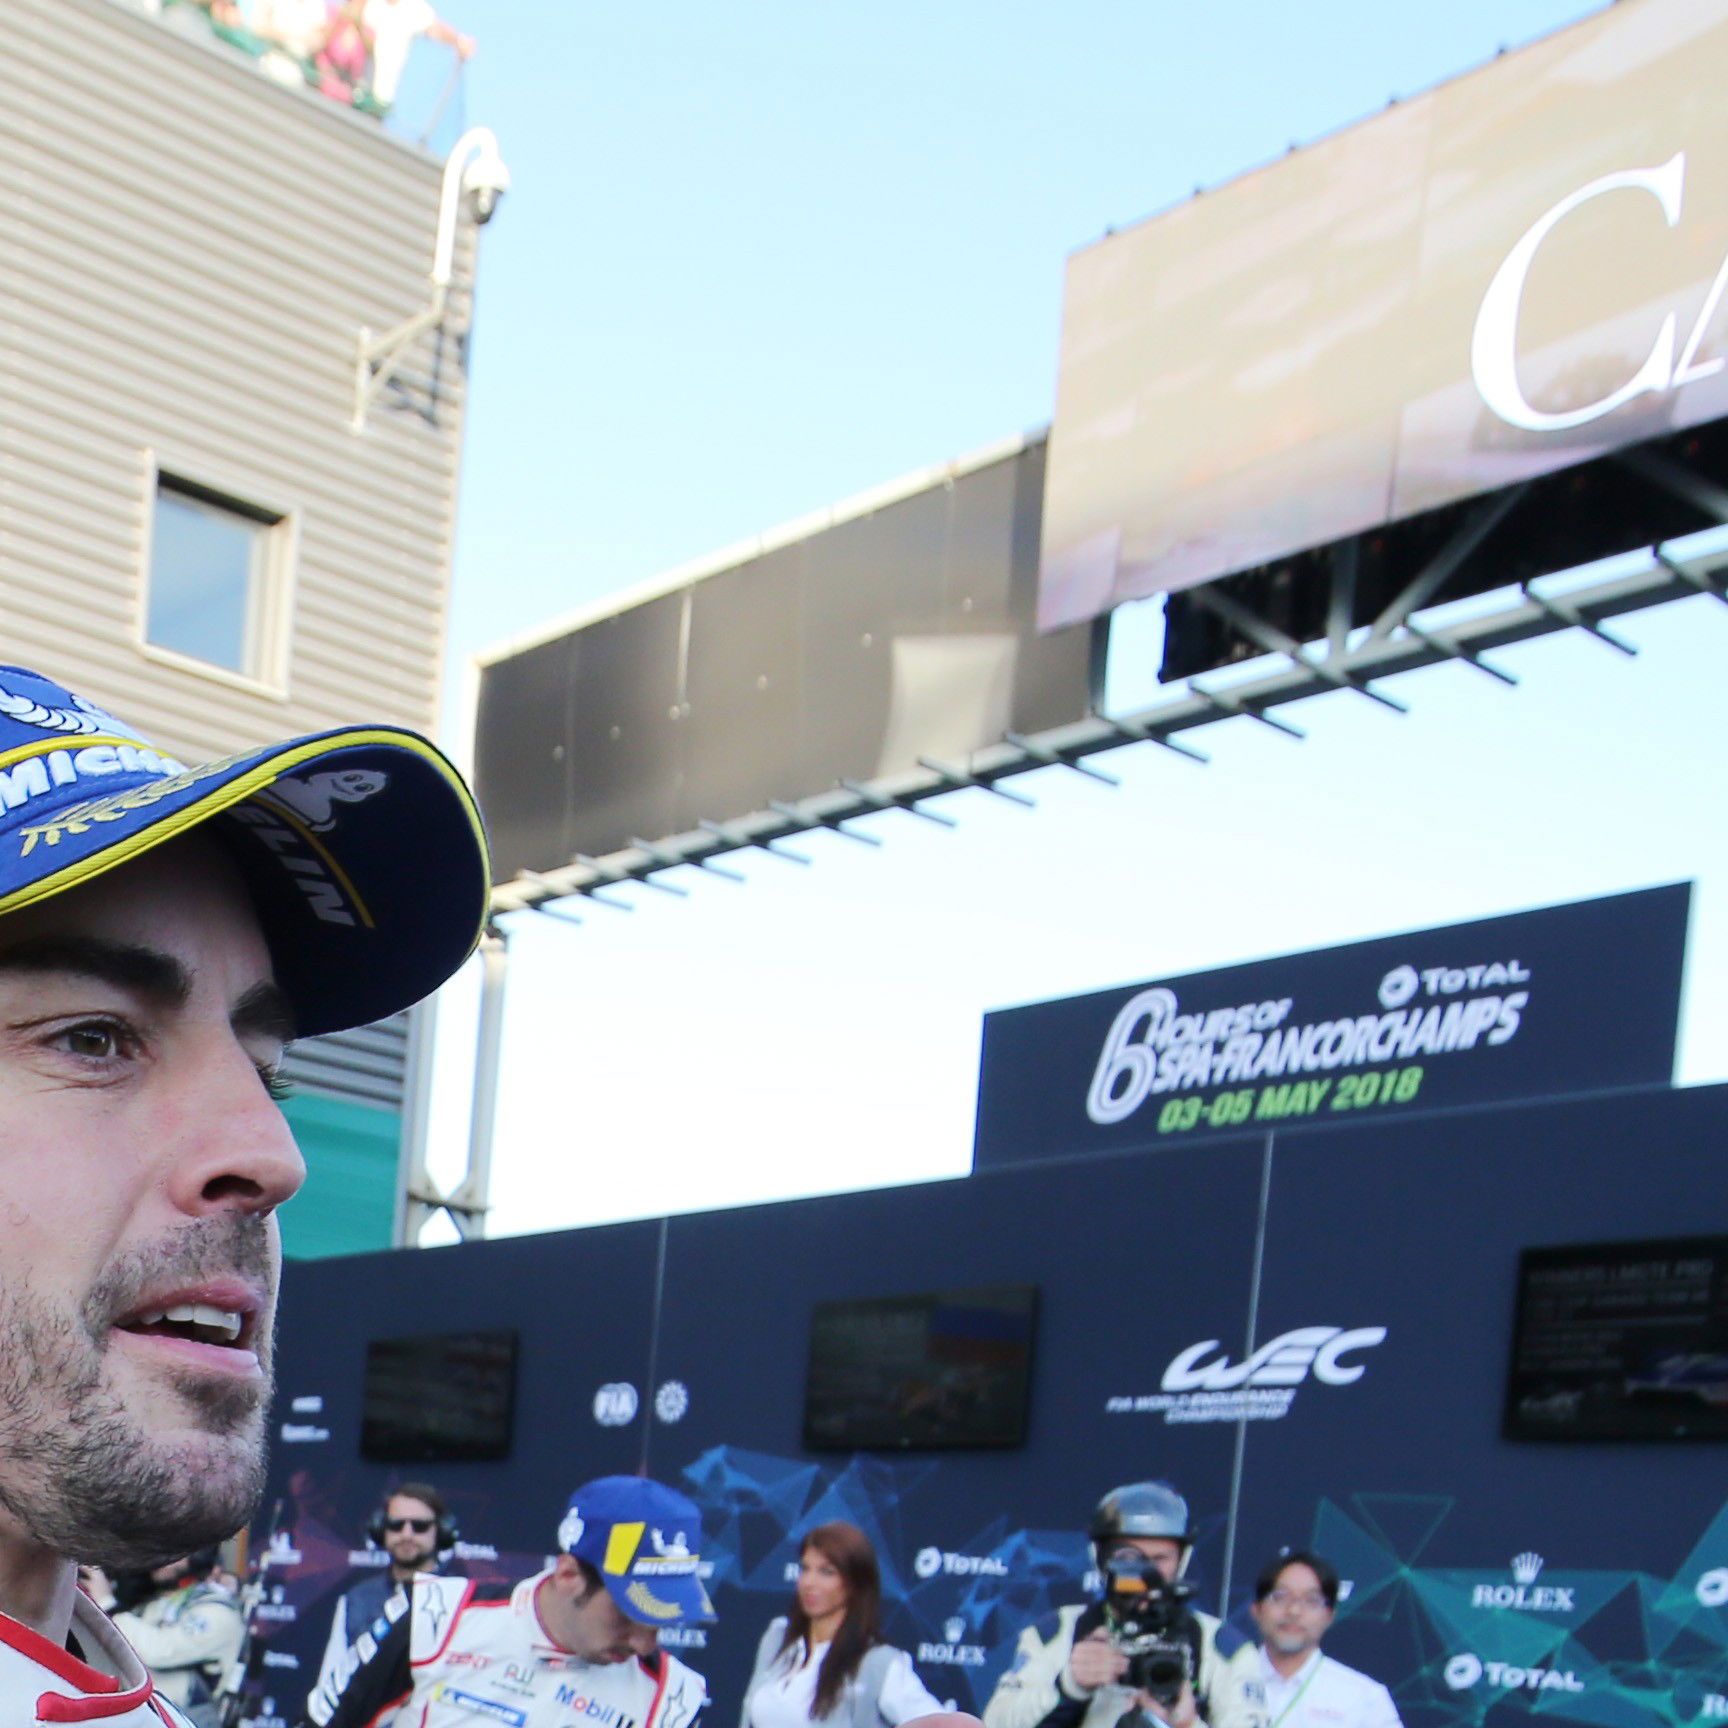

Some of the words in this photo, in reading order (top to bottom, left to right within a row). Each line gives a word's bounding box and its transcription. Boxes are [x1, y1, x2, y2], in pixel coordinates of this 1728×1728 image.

[1473, 150, 1728, 431] C
[1421, 960, 1530, 996] TOTAL
[1145, 1005, 1254, 1050] HOURS
[1255, 998, 1293, 1030] OF
[1152, 992, 1529, 1094] SPA-FRANCORCHAMPS
[1087, 988, 1179, 1124] 6
[1158, 1088, 1254, 1133] 03-05
[1255, 1078, 1333, 1122] MAY
[1330, 1066, 1424, 1112] 2018
[1161, 1326, 1387, 1391] WEC
[943, 1552, 1008, 1576] TOTAL
[1473, 1584, 1574, 1611] ROLEX
[919, 1643, 986, 1666] ROLEX
[1484, 1661, 1584, 1692] TOTAL
[556, 1684, 613, 1723] Mobil
